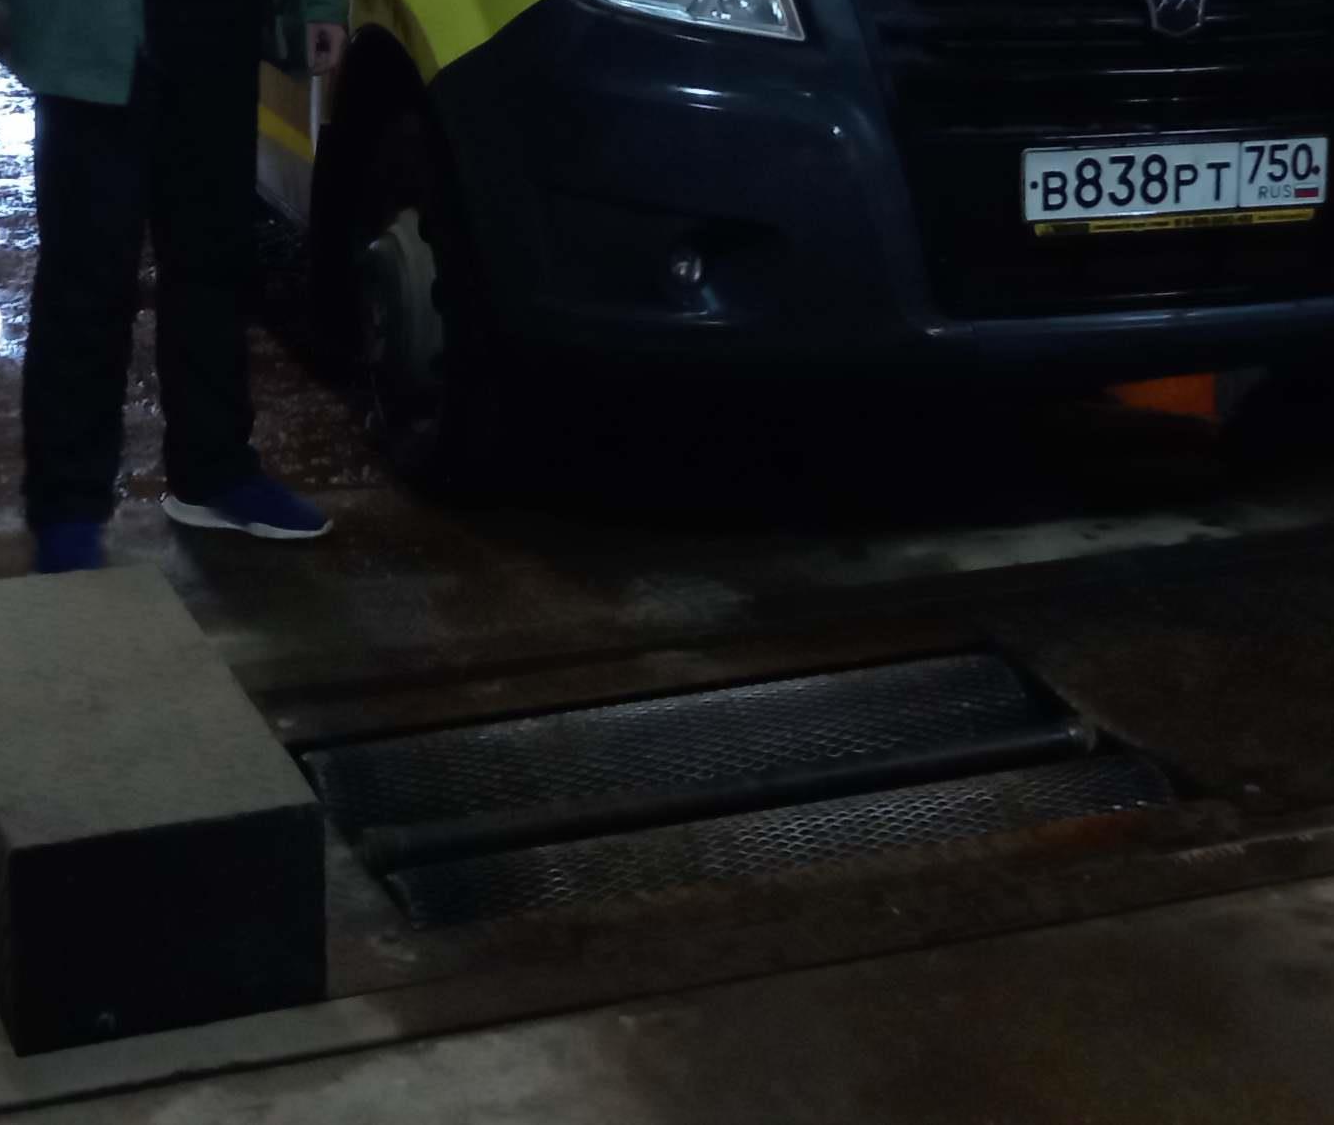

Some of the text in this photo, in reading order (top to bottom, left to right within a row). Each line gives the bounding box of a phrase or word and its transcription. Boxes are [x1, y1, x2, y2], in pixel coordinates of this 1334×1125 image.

[1042, 143, 1314, 211] В838РТ 750
[1257, 183, 1294, 201] RUS
